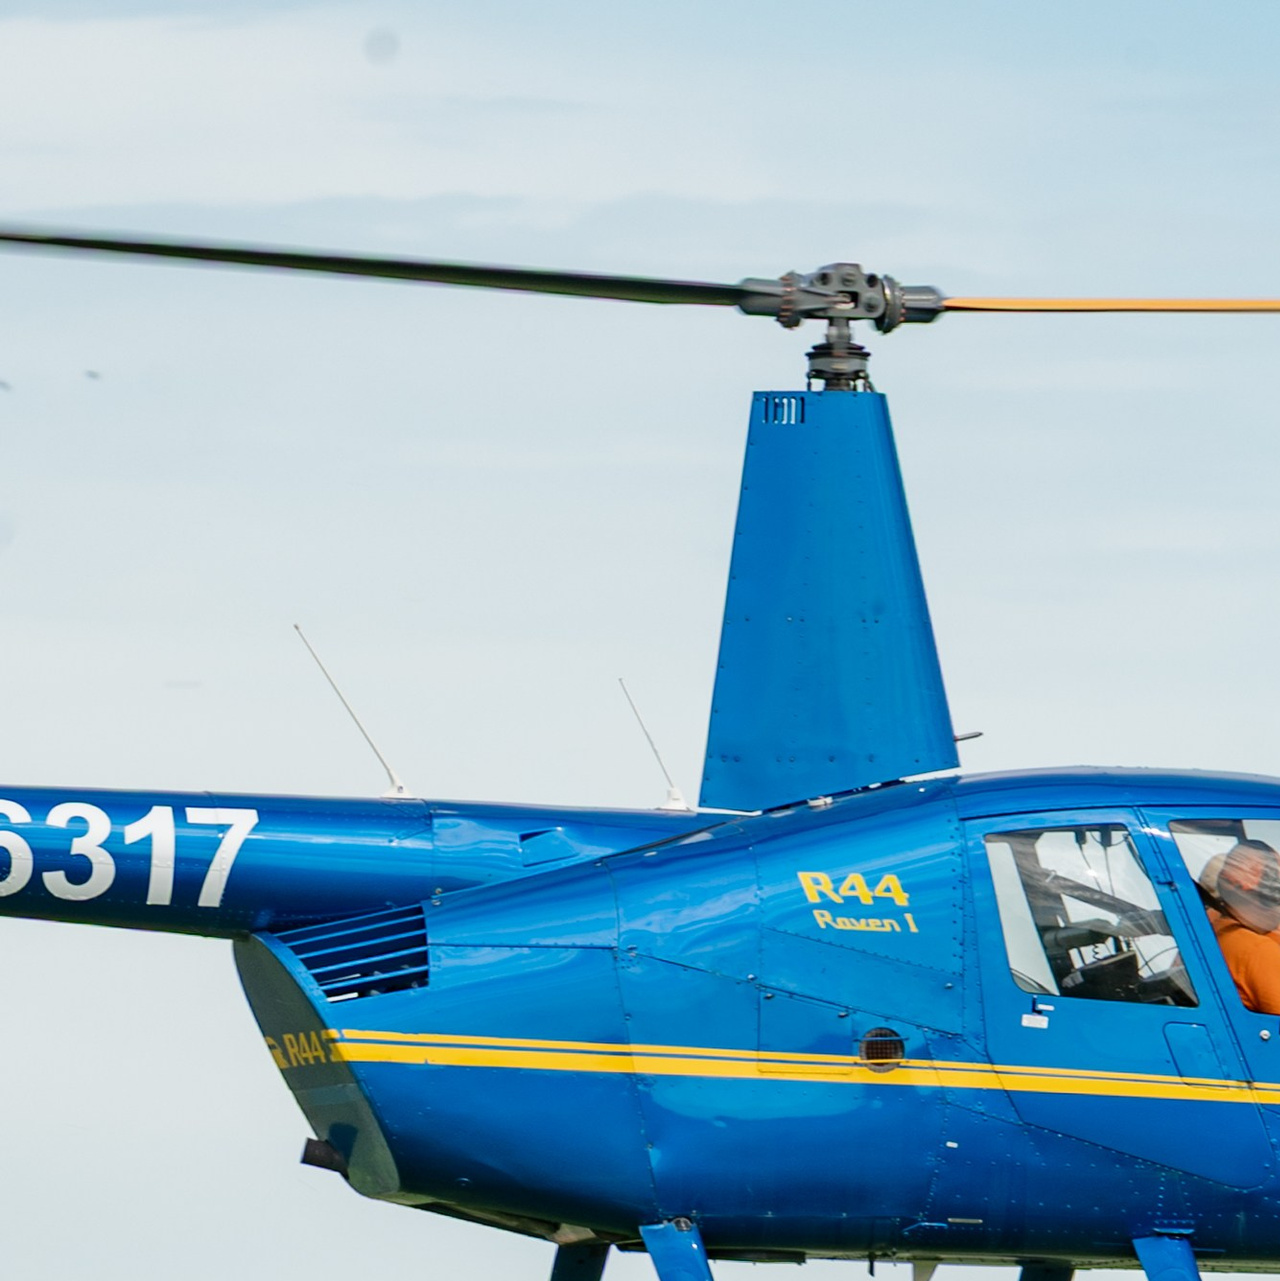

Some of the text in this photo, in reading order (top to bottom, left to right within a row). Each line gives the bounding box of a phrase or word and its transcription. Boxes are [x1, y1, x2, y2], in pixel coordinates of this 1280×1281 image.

[796, 871, 910, 906] R44
[812, 909, 902, 932] Raven
[282, 1030, 327, 1067] R44
